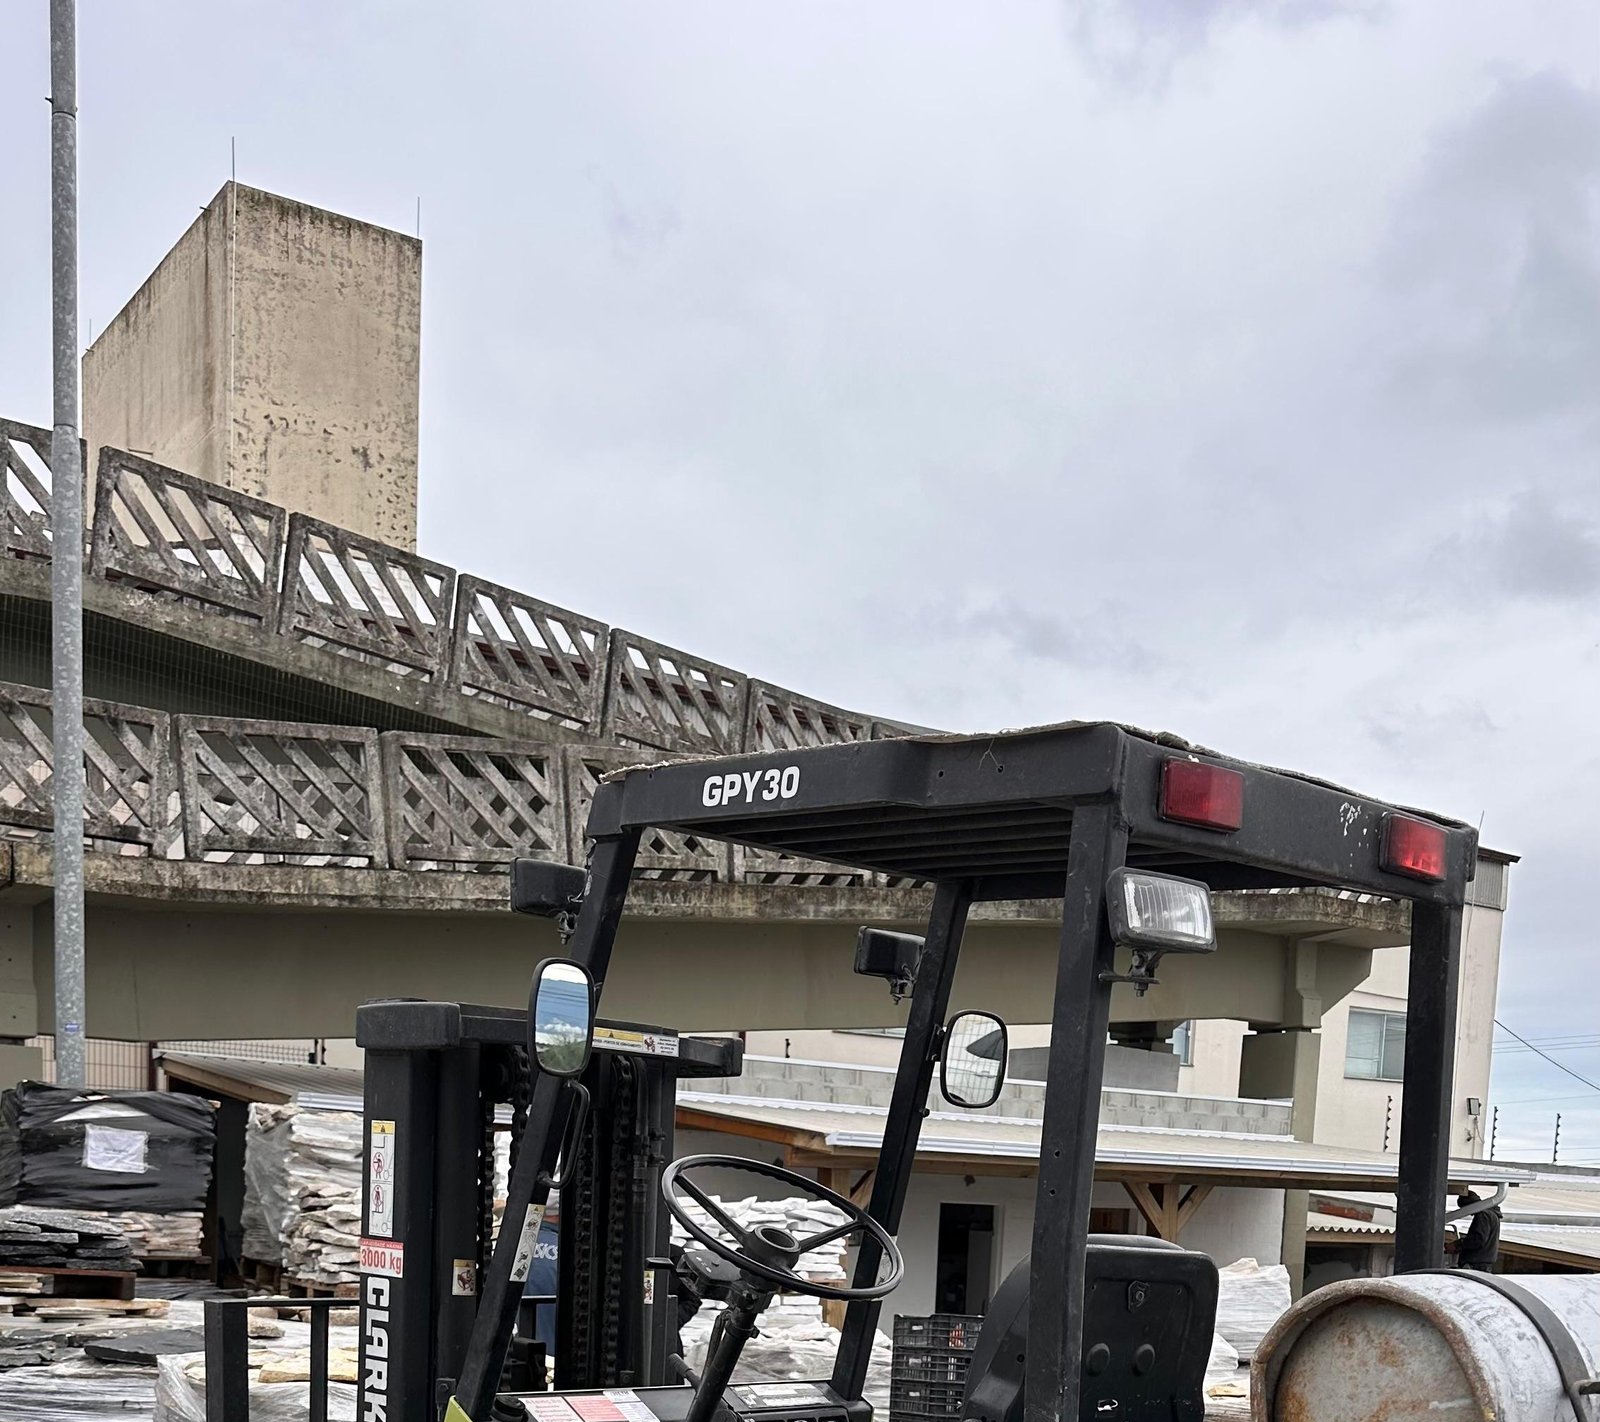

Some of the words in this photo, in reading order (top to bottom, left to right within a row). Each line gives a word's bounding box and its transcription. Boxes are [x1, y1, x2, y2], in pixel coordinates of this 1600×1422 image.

[702, 765, 800, 807] GPY30
[361, 1249, 386, 1269] 3000
[389, 1251, 402, 1275] kg
